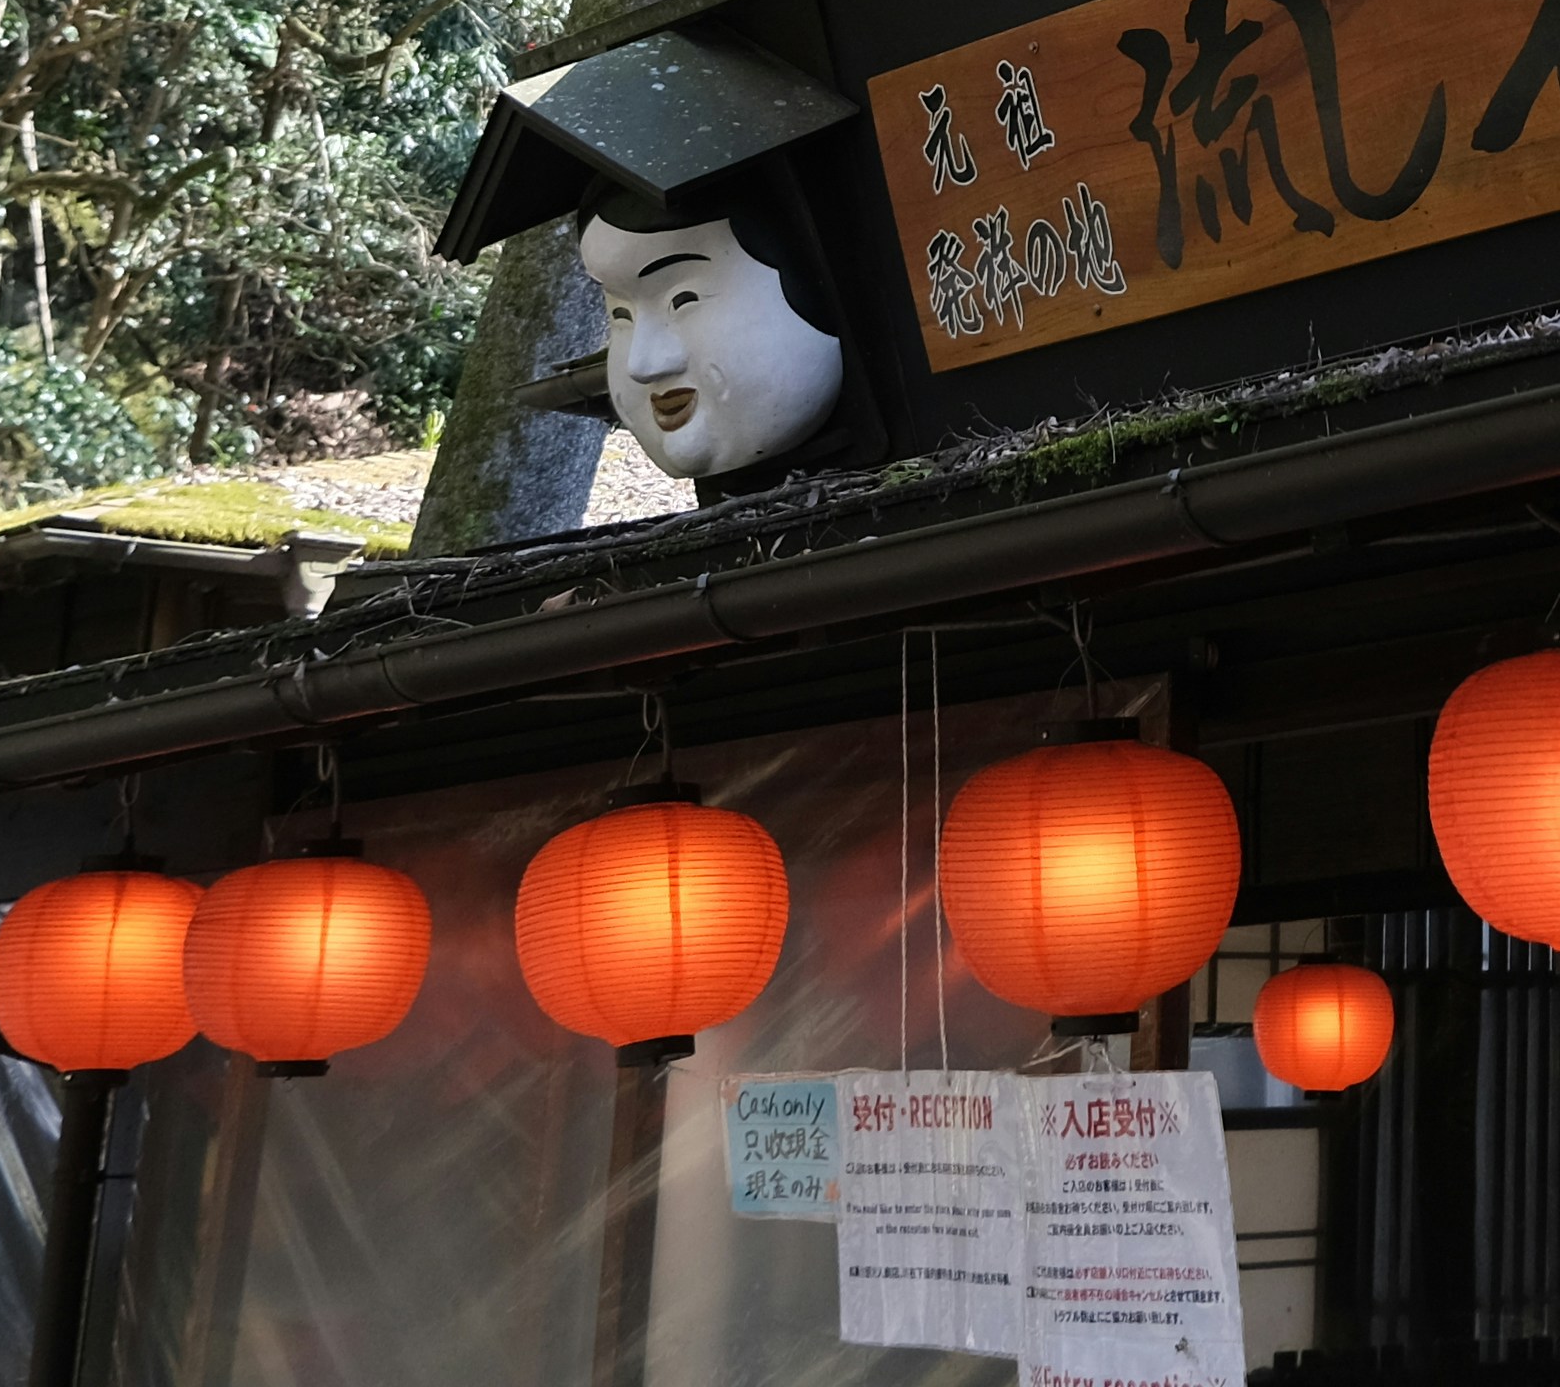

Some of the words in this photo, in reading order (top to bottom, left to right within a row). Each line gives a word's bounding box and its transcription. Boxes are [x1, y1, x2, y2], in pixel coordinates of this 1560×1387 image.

[918, 59, 1056, 195] 元祖
[926, 181, 1128, 339] 発祥の地
[738, 1090, 779, 1121] Cash
[783, 1092, 825, 1125] only
[1065, 1151, 1159, 1170] 必ずお読みください
[745, 1169, 823, 1200] 現金のみ
